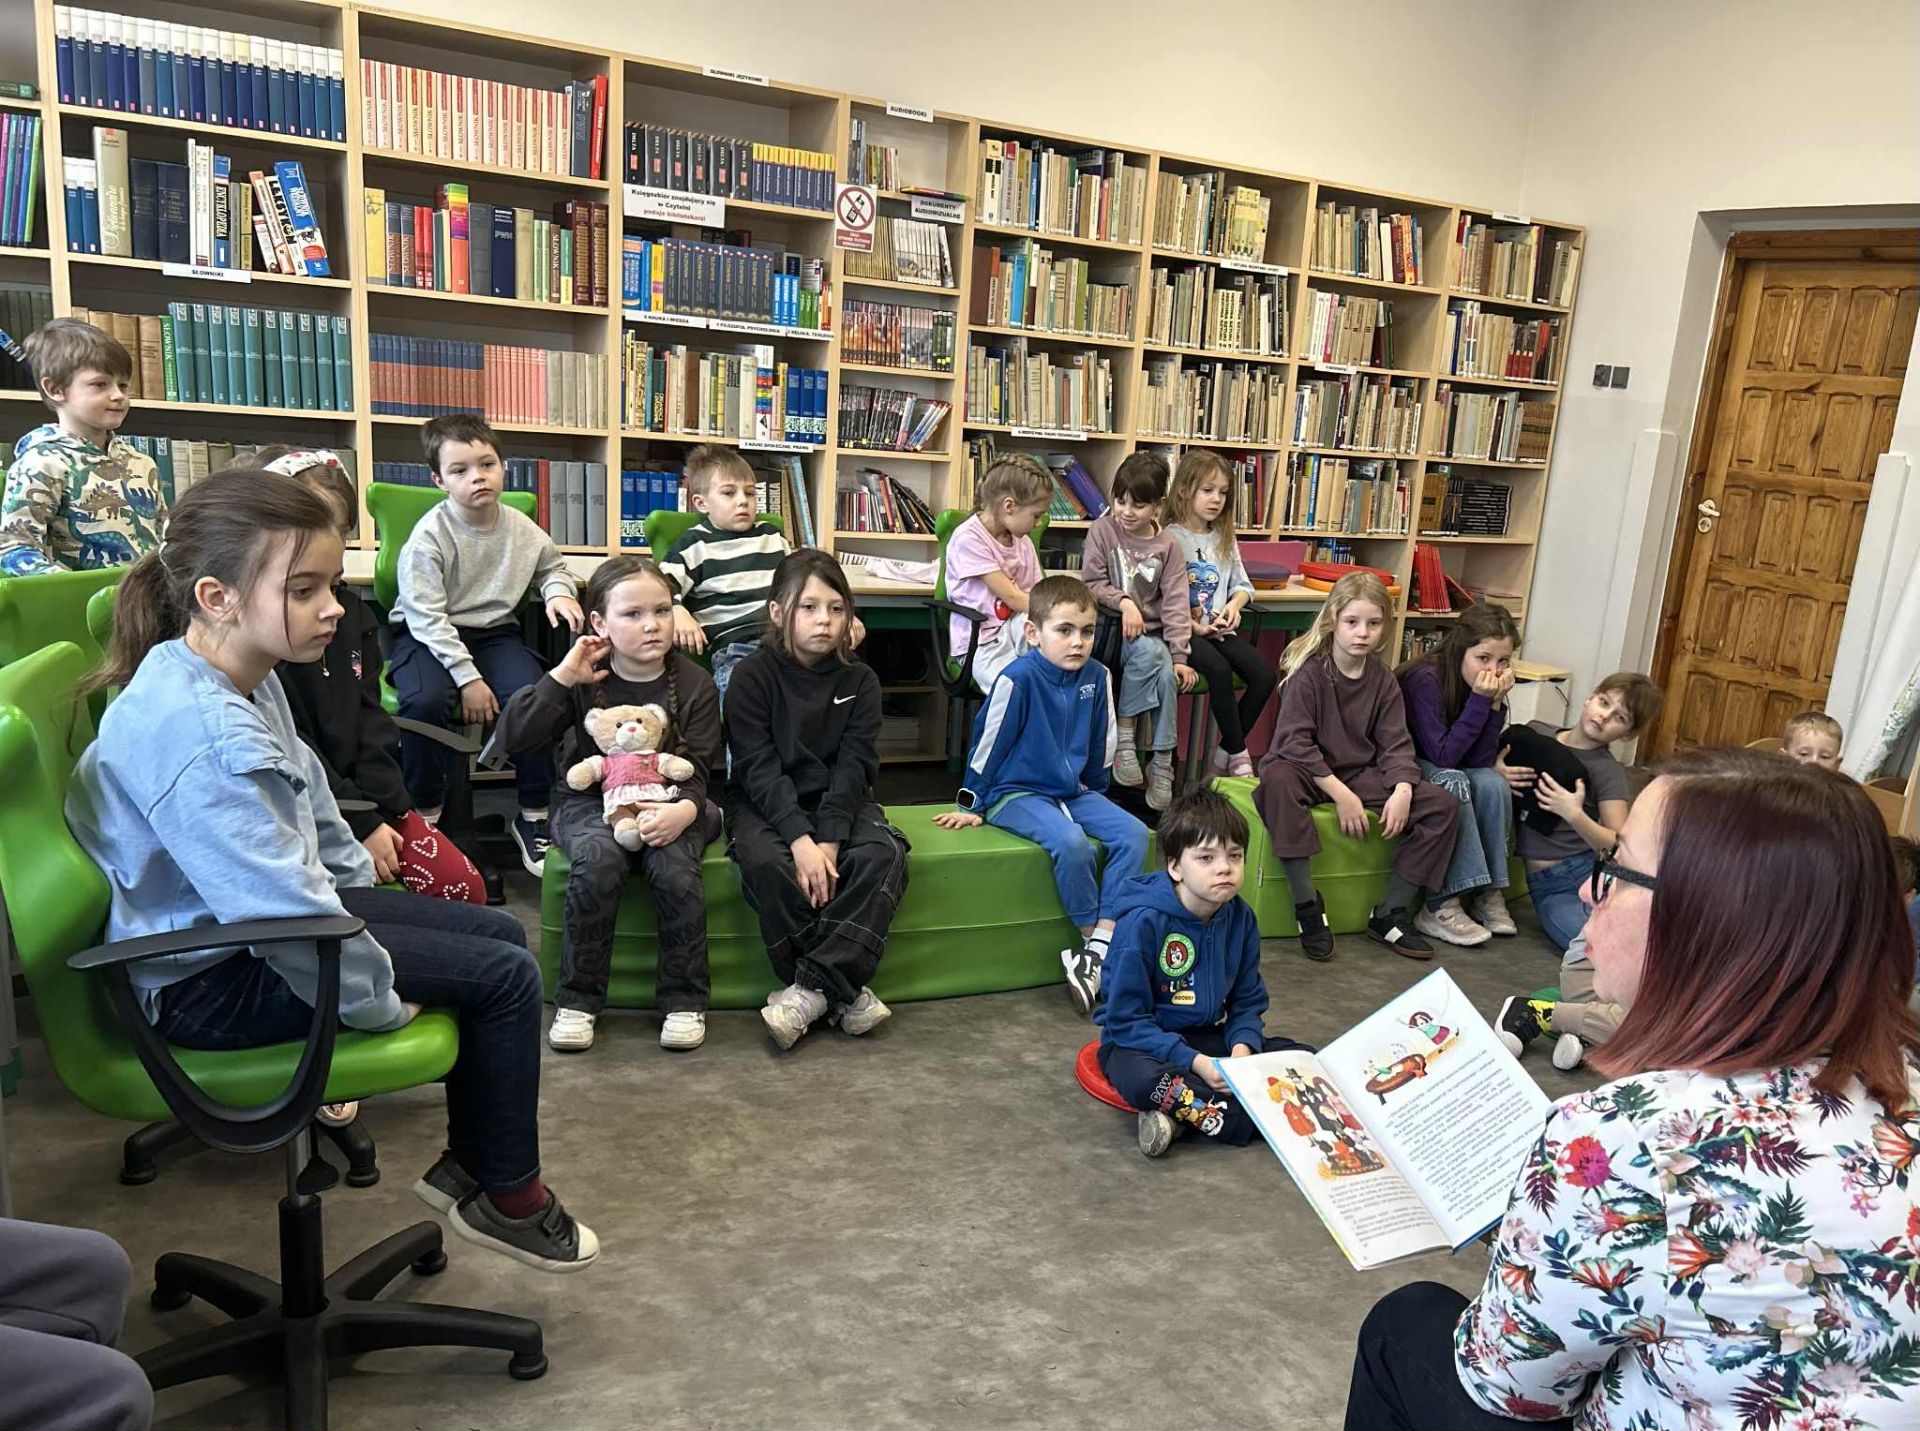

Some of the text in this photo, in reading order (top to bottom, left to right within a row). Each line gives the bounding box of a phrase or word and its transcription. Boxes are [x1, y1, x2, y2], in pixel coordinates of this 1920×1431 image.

[269, 180, 297, 244] LEKSYKON
[163, 323, 173, 360] SŁOWNIK
[1150, 1073, 1171, 1104] PAW
